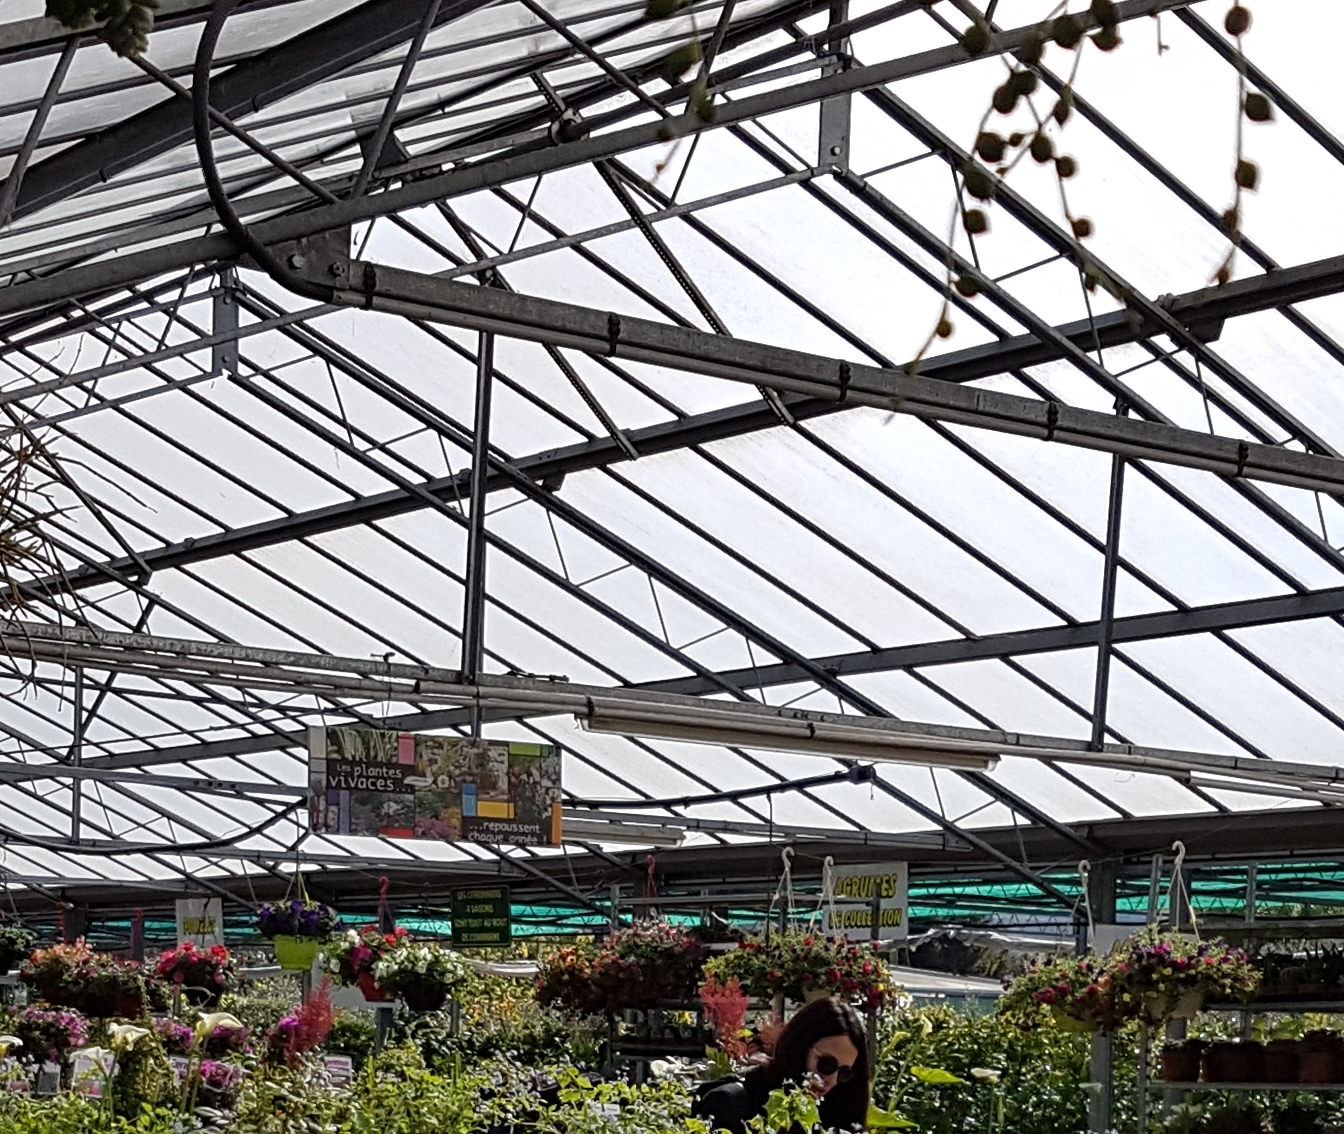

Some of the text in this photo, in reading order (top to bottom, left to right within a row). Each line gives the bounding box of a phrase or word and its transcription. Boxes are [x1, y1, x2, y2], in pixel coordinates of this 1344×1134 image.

[337, 763, 403, 779] Les plantes
[468, 831, 504, 844] chaque
[844, 908, 903, 928] COLLETION
